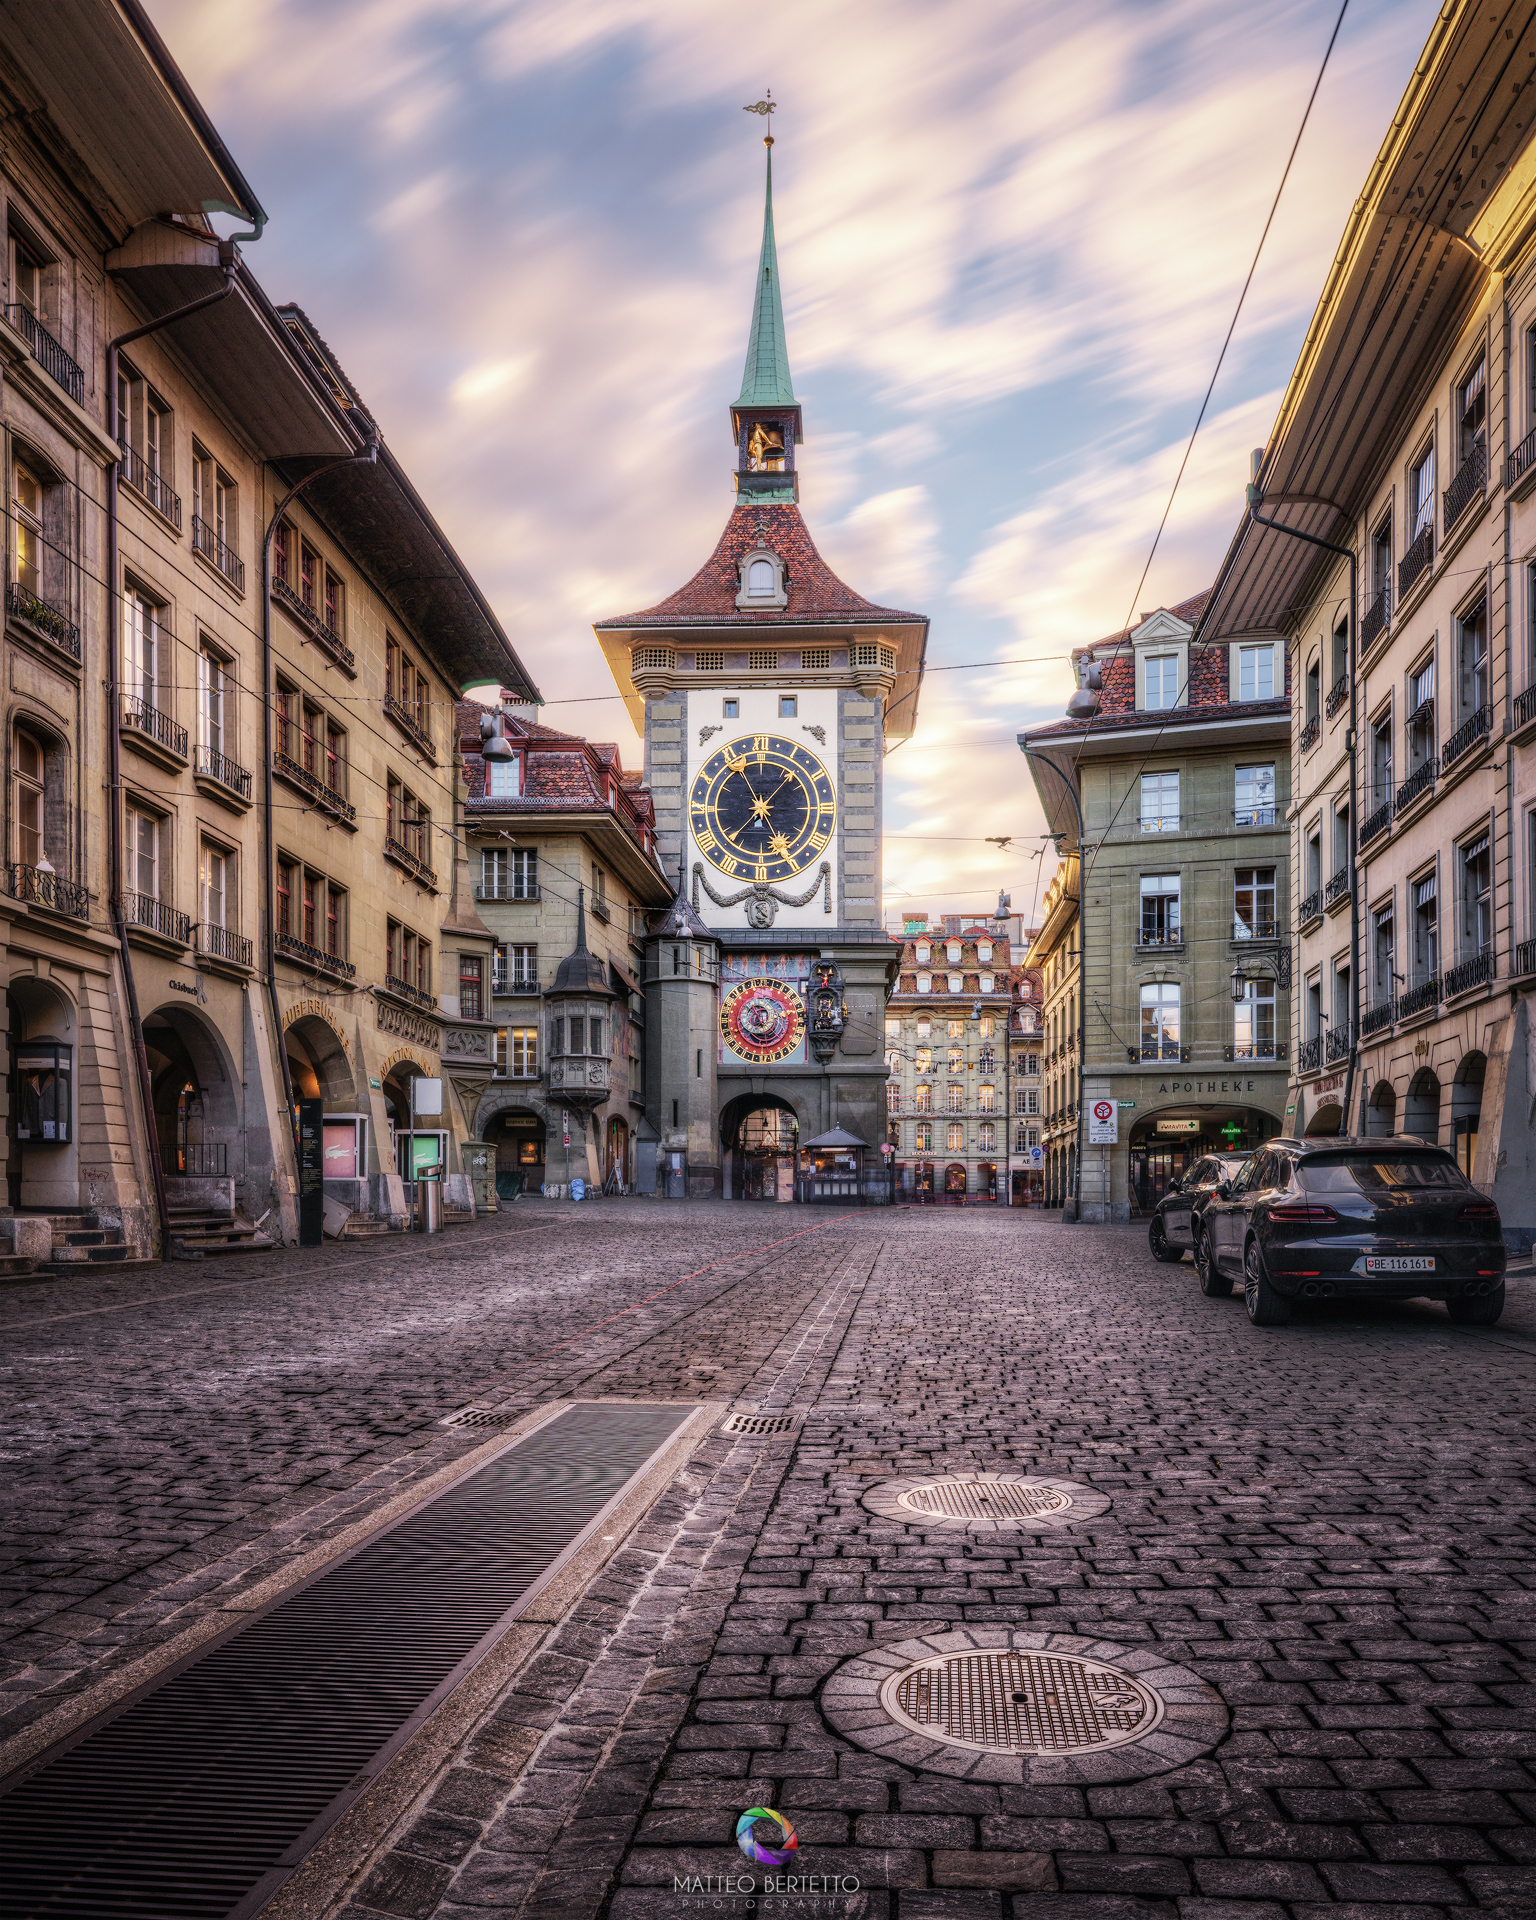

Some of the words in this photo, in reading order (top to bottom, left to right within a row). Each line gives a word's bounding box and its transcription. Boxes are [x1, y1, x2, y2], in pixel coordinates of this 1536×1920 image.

[752, 737, 769, 750] XII
[700, 771, 713, 784] X
[811, 768, 825, 782] II
[820, 802, 834, 814] III
[1159, 1081, 1254, 1093] APOTHEKE
